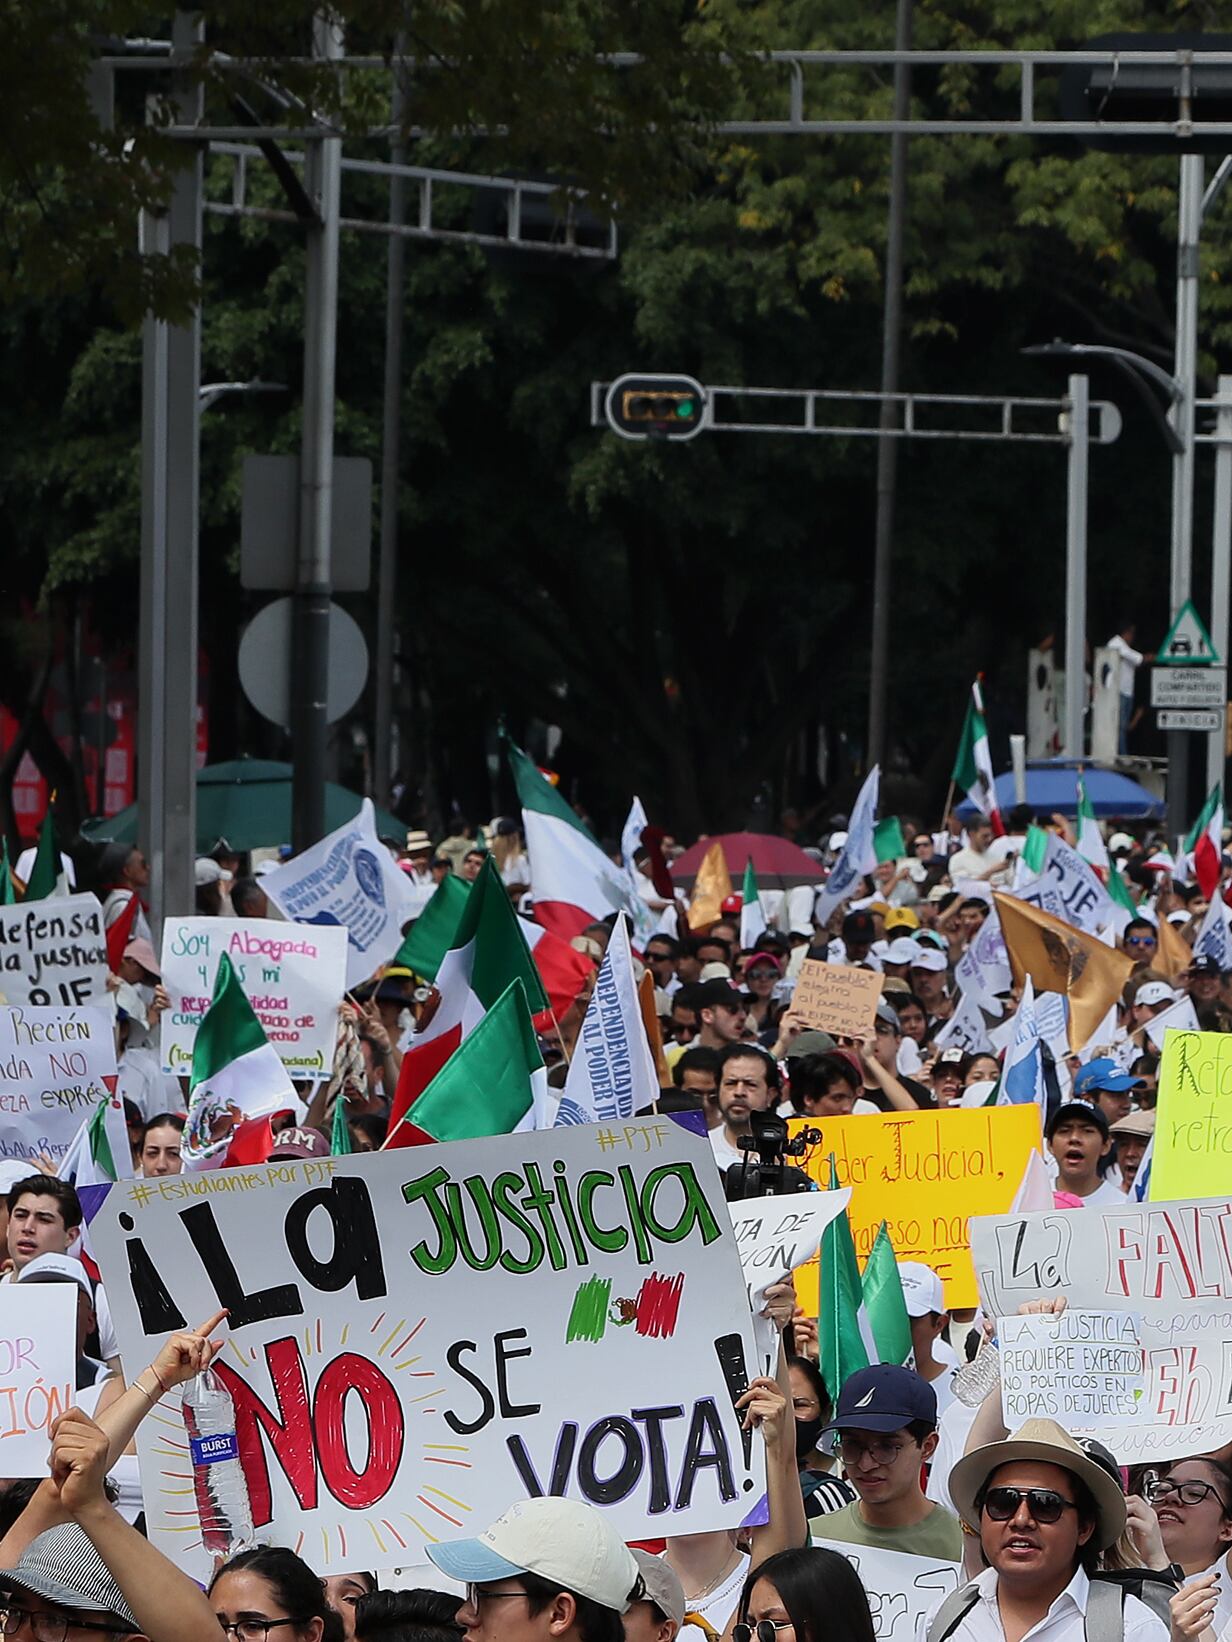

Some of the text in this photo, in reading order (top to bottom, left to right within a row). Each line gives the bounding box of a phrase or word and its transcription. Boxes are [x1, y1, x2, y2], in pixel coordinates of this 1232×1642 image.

[171, 926, 318, 962] Soy Abogada
[262, 966, 282, 983] mi
[8, 1006, 91, 1046] Recién
[49, 1052, 88, 1080] NO
[586, 1047, 614, 1101] PODER
[595, 1124, 672, 1153] #PJF
[265, 1165, 297, 1190] por
[302, 1160, 339, 1186] PJF
[772, 1211, 816, 1236] DE
[994, 1220, 1072, 1290] La
[1003, 1320, 1037, 1343] LA
[1004, 1345, 1143, 1374] REQUIERE EXPERTOS
[1004, 1371, 1127, 1392] NO POLÍTICOS EN
[1007, 1392, 1059, 1416] ROPAS
[1064, 1395, 1082, 1413] DE
[210, 1327, 542, 1527] NO SE
[201, 1438, 231, 1452] BURST
